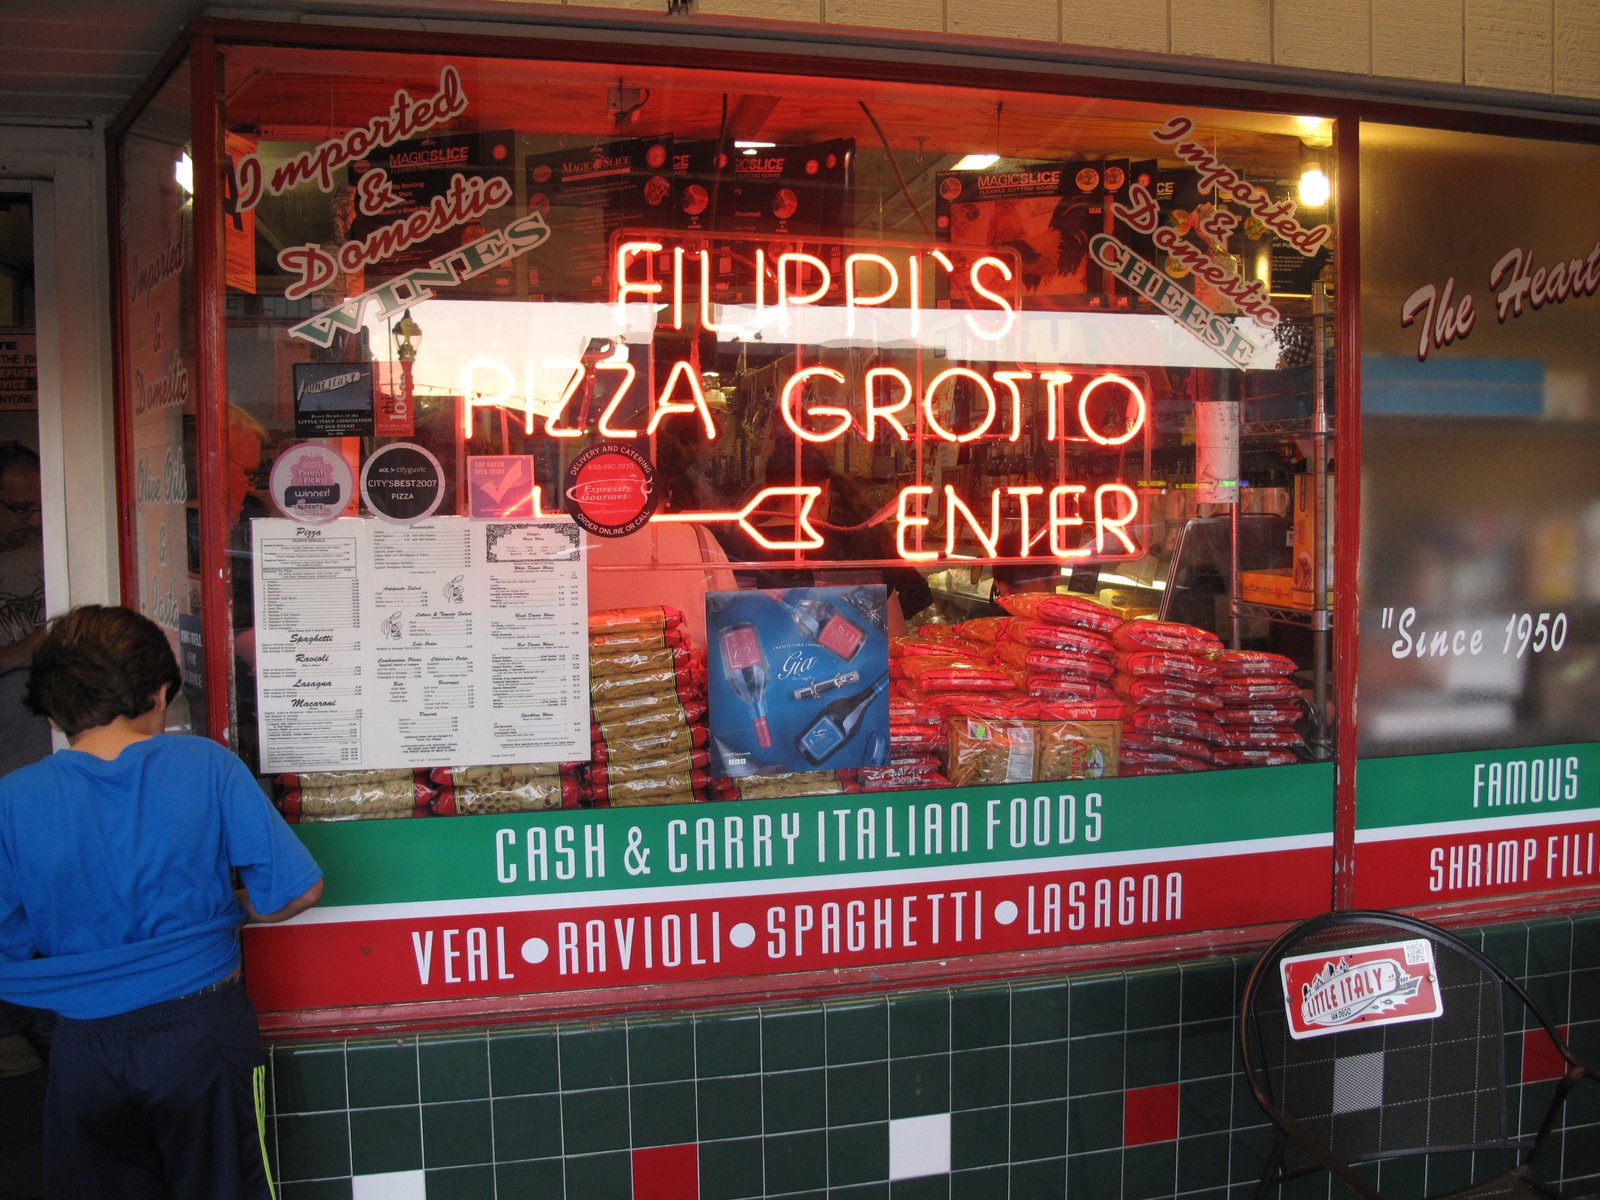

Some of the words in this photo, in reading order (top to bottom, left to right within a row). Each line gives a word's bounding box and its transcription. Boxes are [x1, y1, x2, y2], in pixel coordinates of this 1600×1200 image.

[235, 64, 470, 213] Imported
[389, 147, 469, 166] MAGICSLICE
[562, 161, 592, 174] MAGIC
[601, 155, 631, 168] SLICE
[977, 171, 1061, 188] MAGICSLICE
[1149, 115, 1331, 257] Imported
[358, 167, 406, 215] &
[277, 172, 513, 301] Domestic
[1200, 210, 1238, 249] &
[1111, 183, 1281, 330] Domestic
[288, 210, 552, 349] WINES
[1088, 233, 1260, 373] CHEESE
[1402, 275, 1478, 361] The
[1489, 242, 1600, 322] Heart
[136, 347, 188, 416] Domestic
[464, 359, 716, 440] PIZZA
[781, 366, 1146, 446] GROTTO
[396, 466, 426, 475] cityguide
[570, 447, 600, 476] DELIVERY
[620, 447, 652, 473] CATERING
[294, 489, 331, 498] winner!
[581, 493, 628, 501] Gourmet
[584, 485, 632, 493] Expressly
[296, 527, 322, 538] Pizza
[577, 513, 598, 532] ORDER
[599, 527, 625, 535] ONLINE
[625, 522, 636, 532] OR
[635, 510, 650, 526] CALL
[896, 483, 1140, 561] ENTER
[290, 634, 334, 645] Spaghetti
[295, 654, 330, 663] Ravioli
[1501, 612, 1568, 662] 1950
[292, 679, 333, 690] Lasagna
[777, 650, 818, 680] Gia
[291, 698, 337, 708] Macaroni
[1473, 756, 1579, 808] FAMOUS
[496, 823, 606, 884] CASH
[623, 826, 651, 876] &
[667, 812, 800, 874] CARRY
[817, 802, 969, 864] ITALIAN
[986, 793, 1103, 851] FOODS
[1429, 837, 1537, 892] SHRIMP
[1546, 832, 1600, 879] FILI
[412, 926, 515, 986] VEAL
[558, 911, 721, 976] RAVIOLI
[767, 890, 982, 960] SPAGHETTI
[1027, 872, 1183, 936] LASAGNA
[1307, 984, 1338, 1018] LITTLE
[1340, 967, 1382, 1005] ITALY
[1331, 1011, 1339, 1021] SAN
[1339, 1007, 1352, 1019] DIEGO
